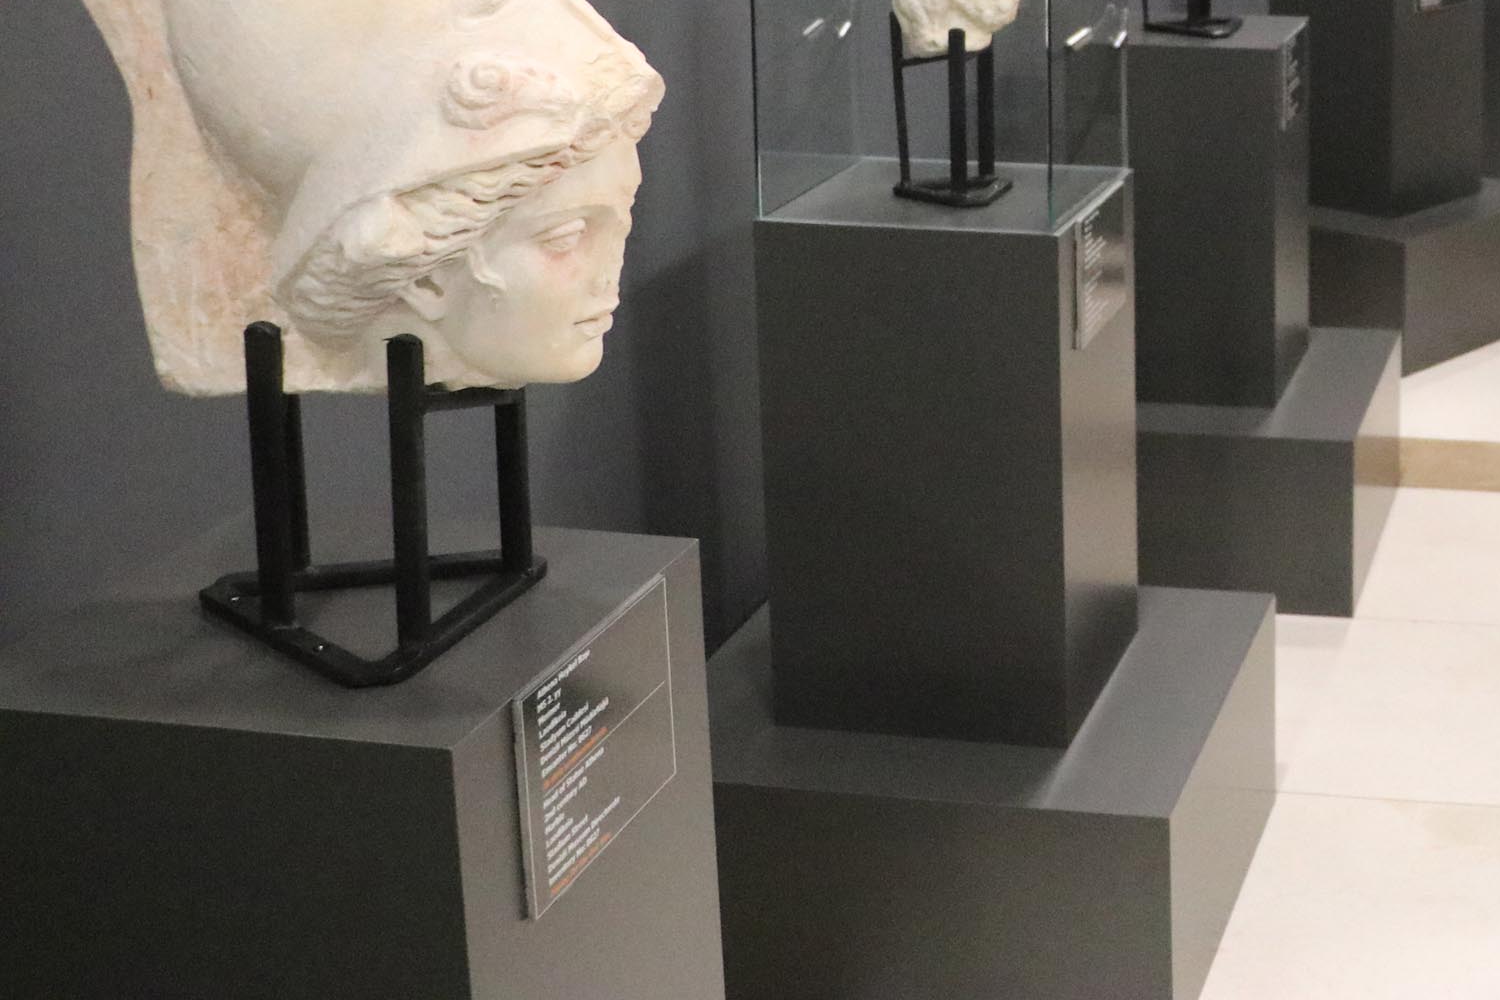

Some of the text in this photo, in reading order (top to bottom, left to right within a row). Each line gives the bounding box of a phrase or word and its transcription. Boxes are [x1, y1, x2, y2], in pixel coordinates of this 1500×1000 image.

[537, 676, 557, 698] Athena
[543, 789, 558, 808] Head
[585, 745, 603, 768] Athena
[568, 824, 590, 852] Museum
